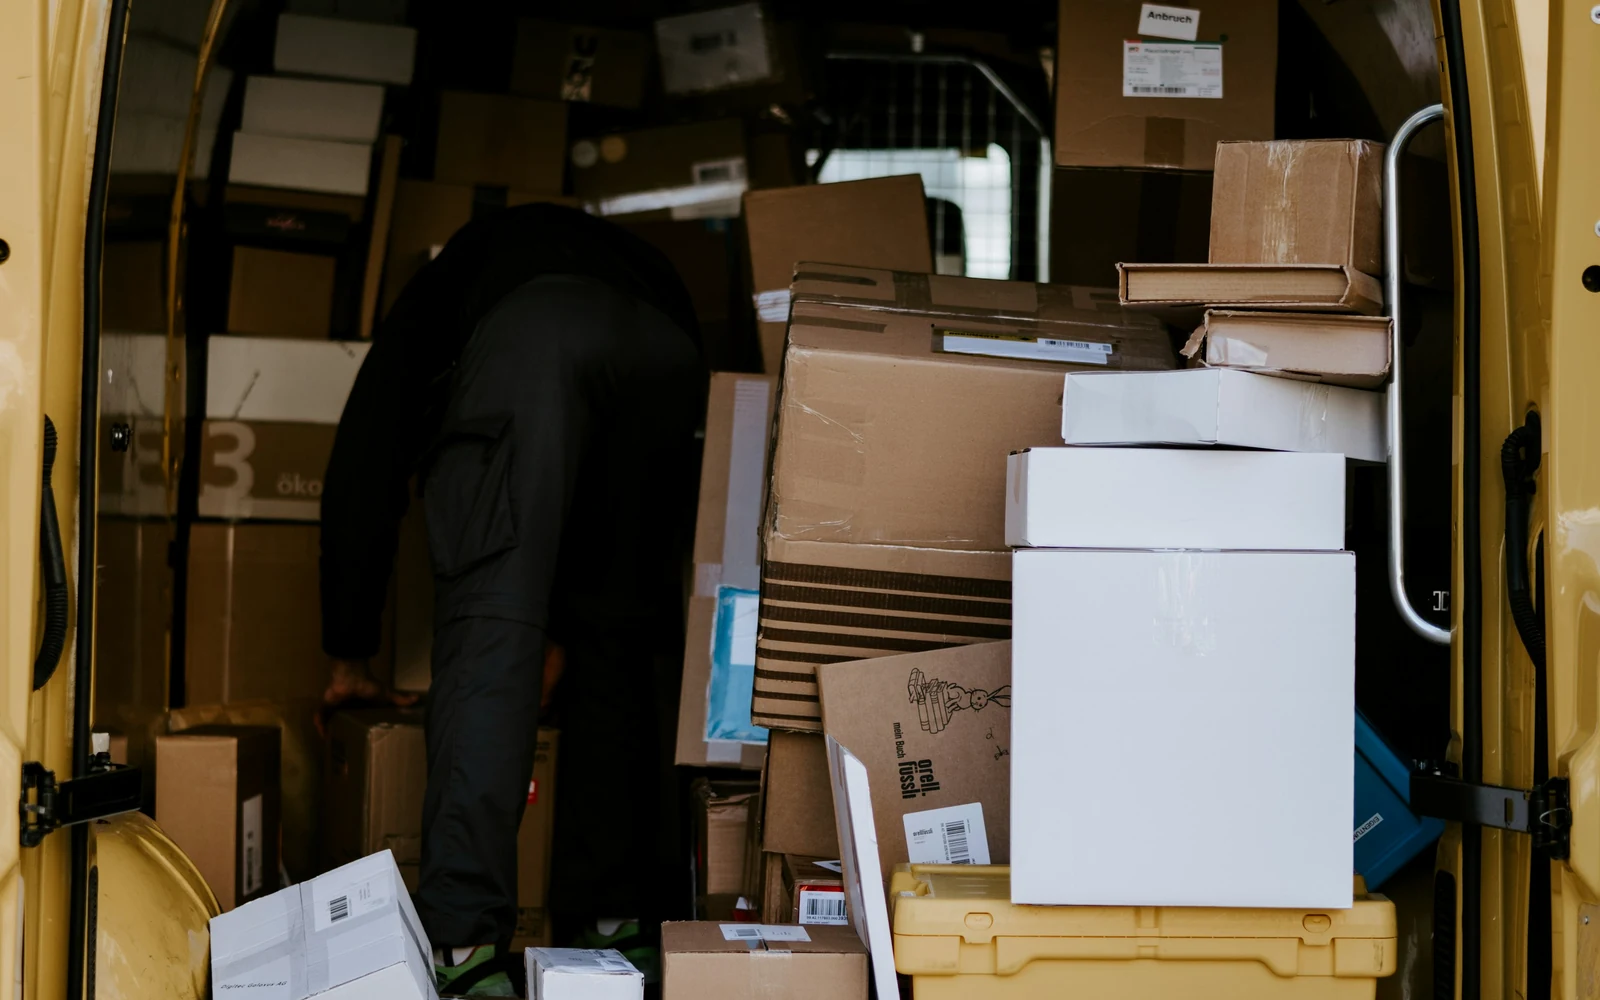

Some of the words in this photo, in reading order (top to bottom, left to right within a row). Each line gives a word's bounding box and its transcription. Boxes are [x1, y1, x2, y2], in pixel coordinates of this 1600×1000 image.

[1147, 11, 1193, 24] Anbruch
[203, 421, 256, 502] 3
[277, 472, 324, 496] öko
[893, 722, 901, 739] mein
[895, 740, 907, 758] Buch
[918, 758, 940, 797] orell.
